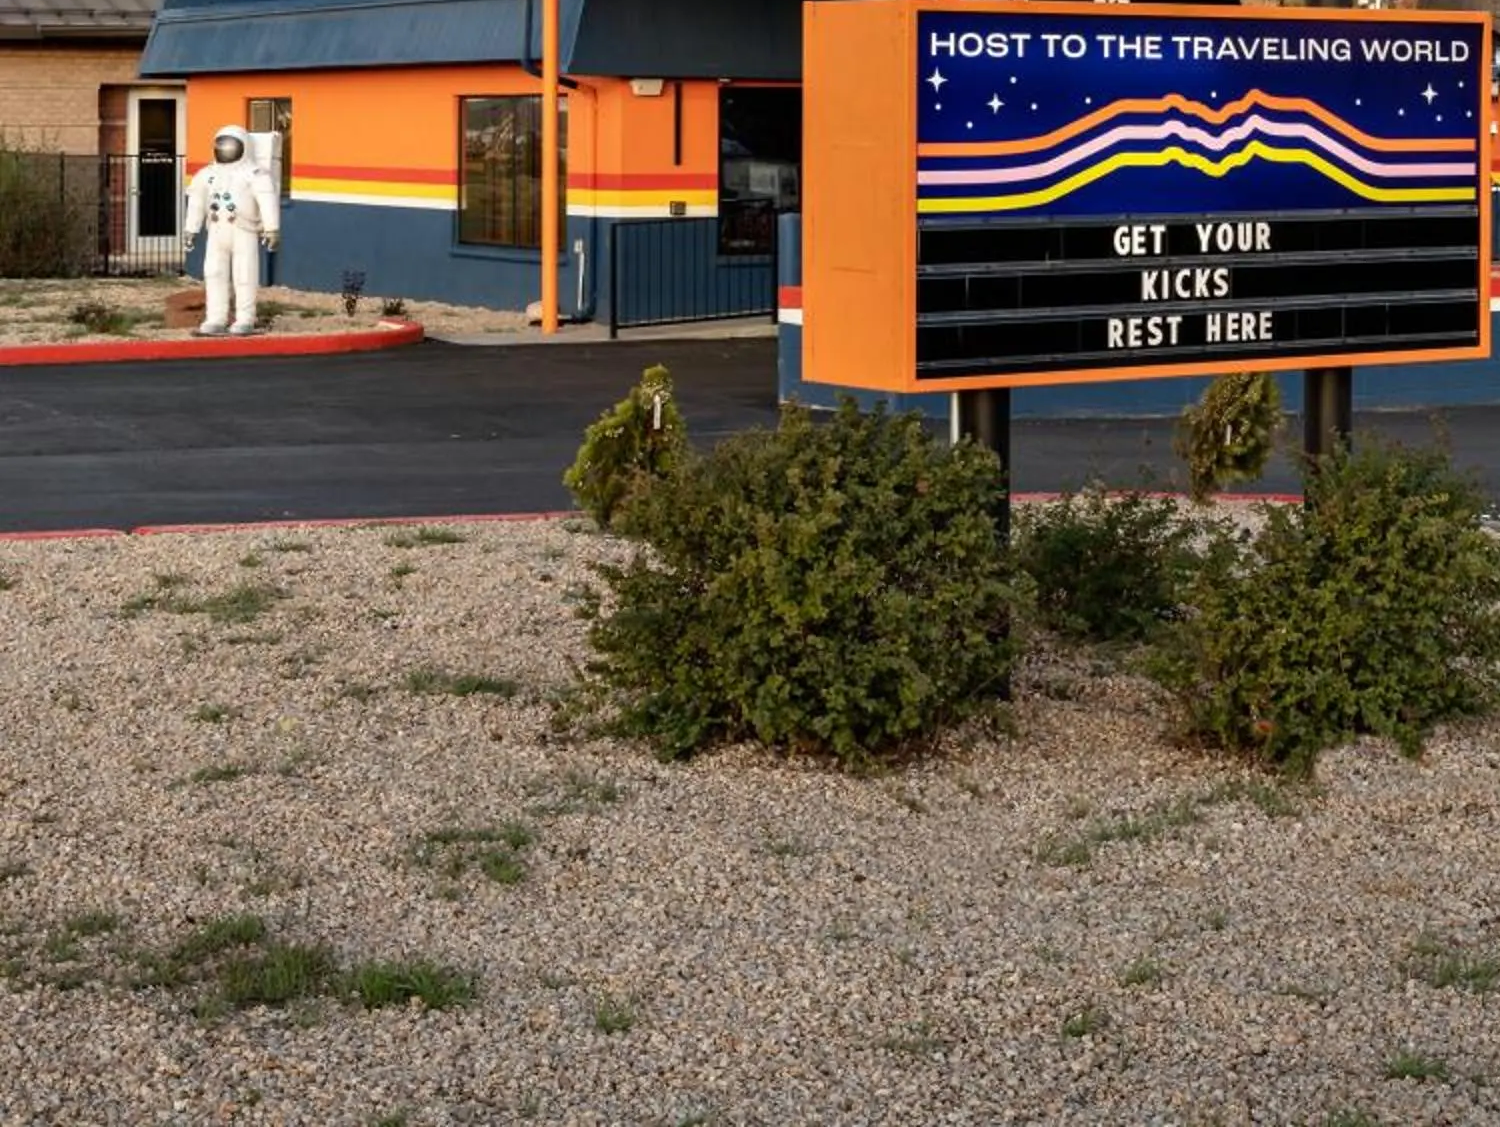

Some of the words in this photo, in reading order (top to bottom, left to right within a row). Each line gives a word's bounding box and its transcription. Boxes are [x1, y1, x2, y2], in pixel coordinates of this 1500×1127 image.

[931, 32, 1031, 58] HOST
[1040, 34, 1087, 58] TO
[1096, 35, 1163, 60] THE
[1171, 36, 1351, 61] TRAVELING
[1360, 39, 1469, 62] WORLD
[1113, 224, 1166, 256] GET
[1195, 222, 1272, 253] YOUR
[1141, 268, 1229, 301] KICKS
[1107, 315, 1183, 349] REST
[1206, 311, 1273, 343] HERE
